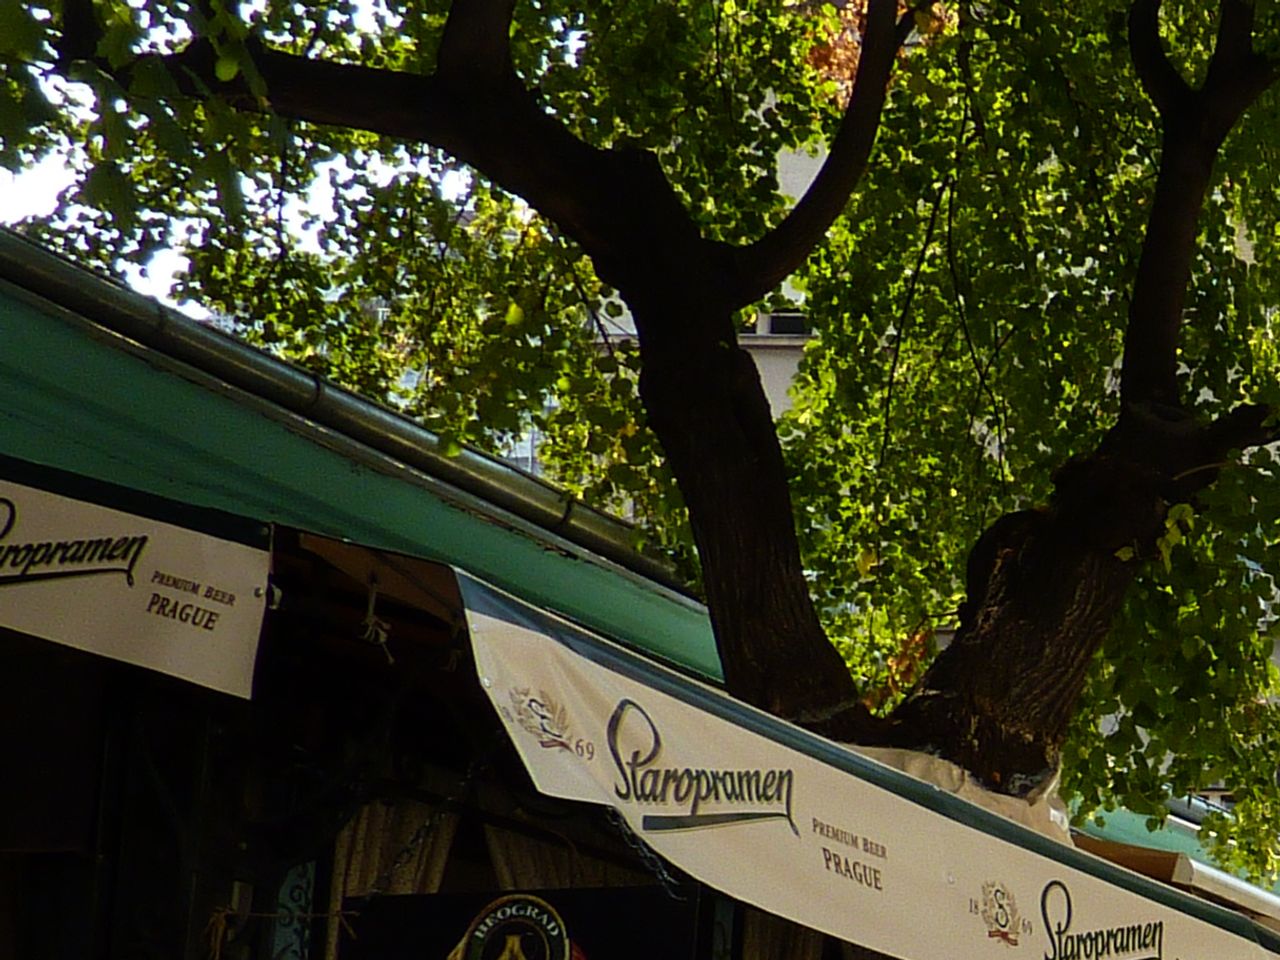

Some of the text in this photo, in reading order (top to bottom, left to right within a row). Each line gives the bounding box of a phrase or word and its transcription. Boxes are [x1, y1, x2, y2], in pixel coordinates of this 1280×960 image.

[146, 592, 220, 631] PRAGUE
[204, 585, 236, 607] BEER
[607, 698, 801, 838] Staropramen
[812, 816, 887, 859] PREMIUM BEER
[822, 846, 883, 891] PRAGUE
[475, 904, 560, 939] BEOGRAD
